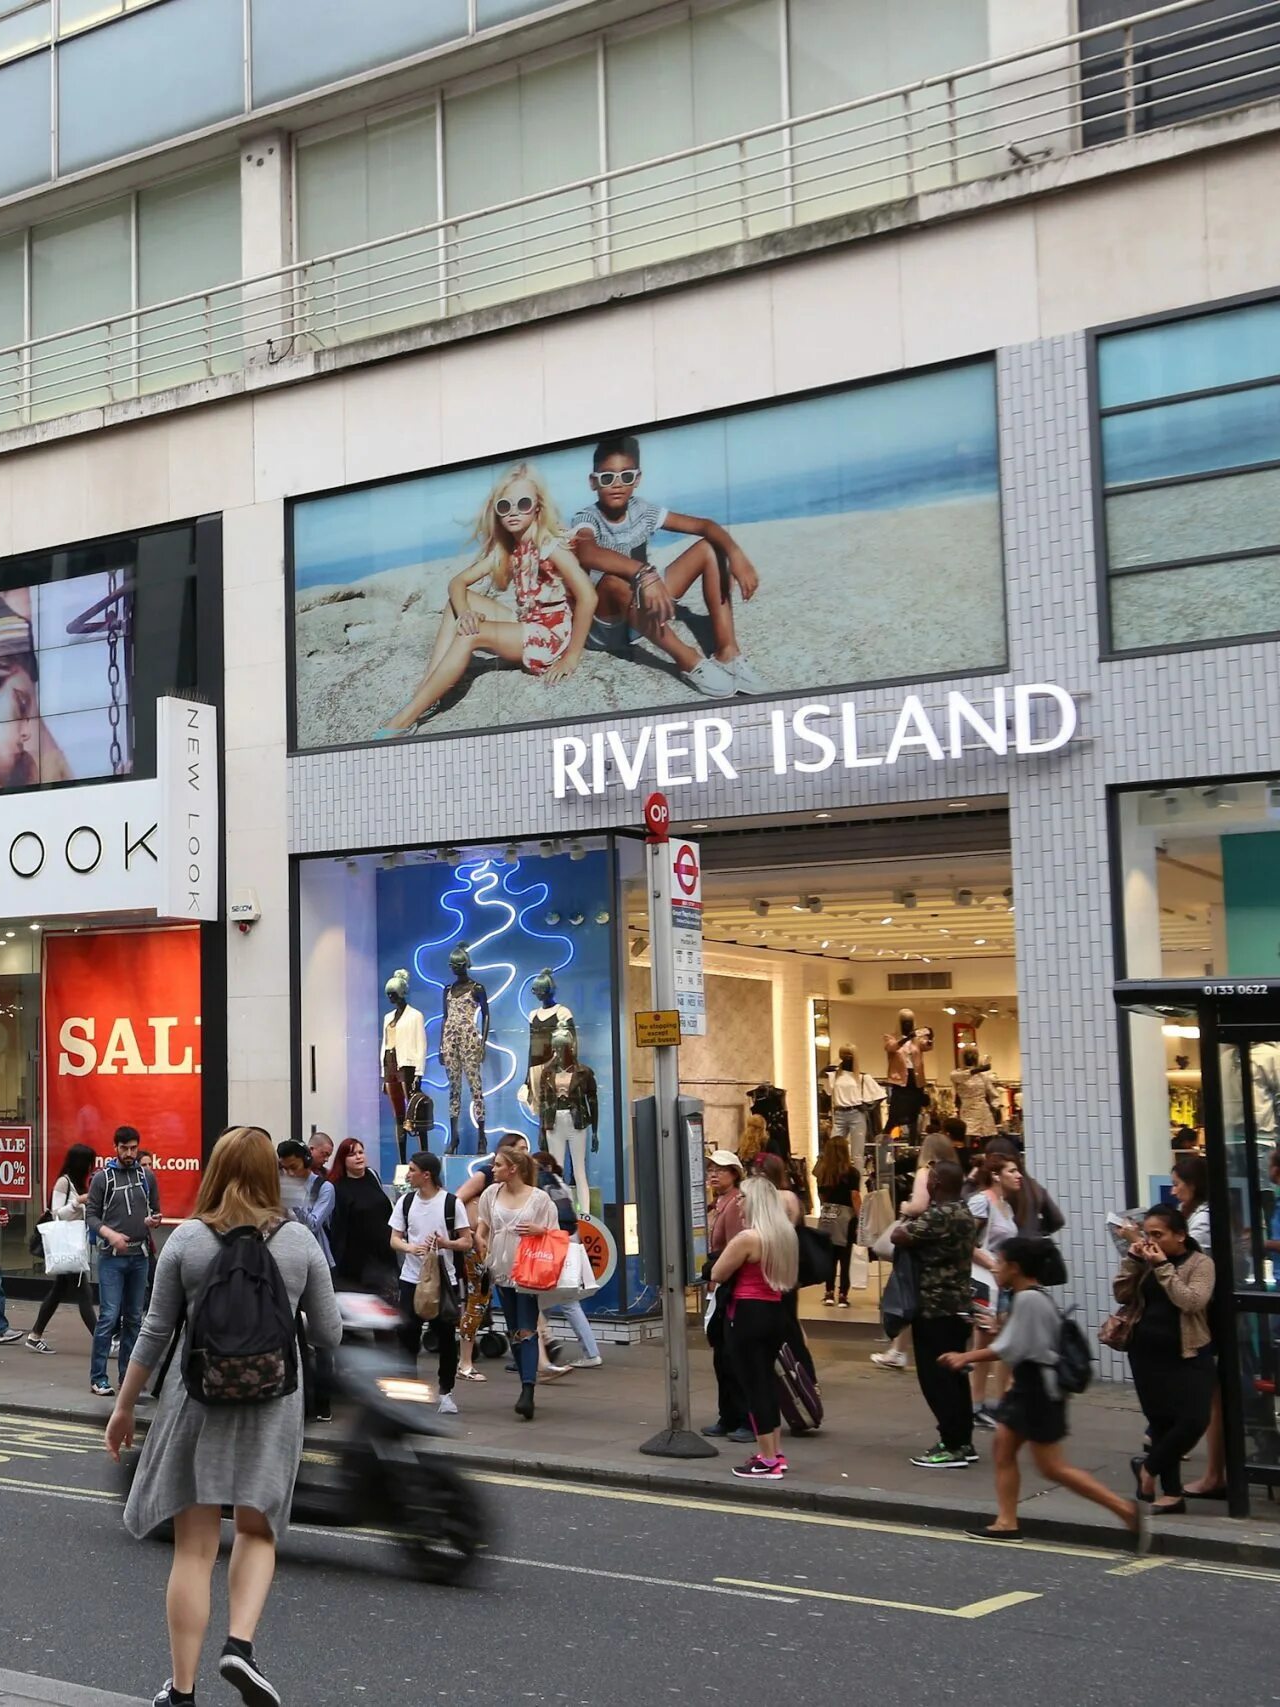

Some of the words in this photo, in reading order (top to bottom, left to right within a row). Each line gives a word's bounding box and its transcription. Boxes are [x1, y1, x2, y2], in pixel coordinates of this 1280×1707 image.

[187, 708, 200, 791] NEW
[553, 718, 738, 798] RIVER
[771, 683, 1076, 774] ISLAND
[650, 804, 668, 823] OP
[188, 813, 200, 912] LOOK
[58, 1015, 202, 1077] SAL
[13, 1177, 25, 1185] off
[580, 1213, 591, 1221] TO
